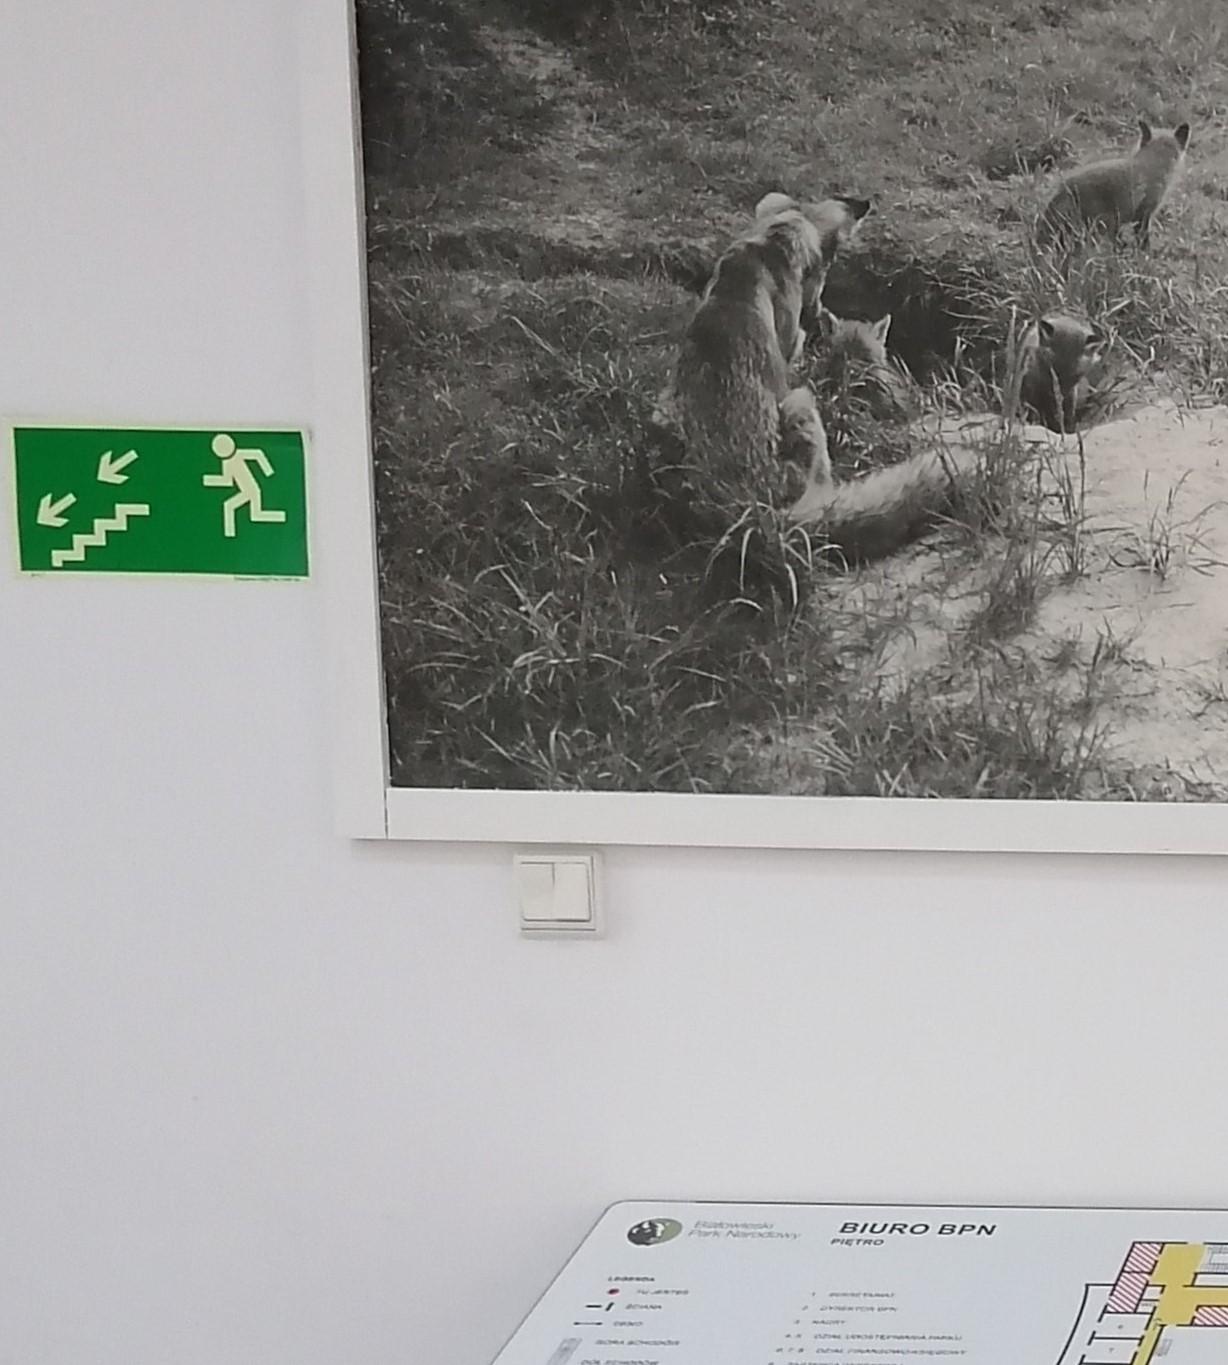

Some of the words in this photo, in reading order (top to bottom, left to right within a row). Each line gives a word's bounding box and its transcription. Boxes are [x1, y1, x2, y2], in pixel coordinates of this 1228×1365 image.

[838, 1222, 930, 1235] BIURO
[937, 1223, 997, 1236] BPN
[830, 1238, 885, 1247] PIĘTRO
